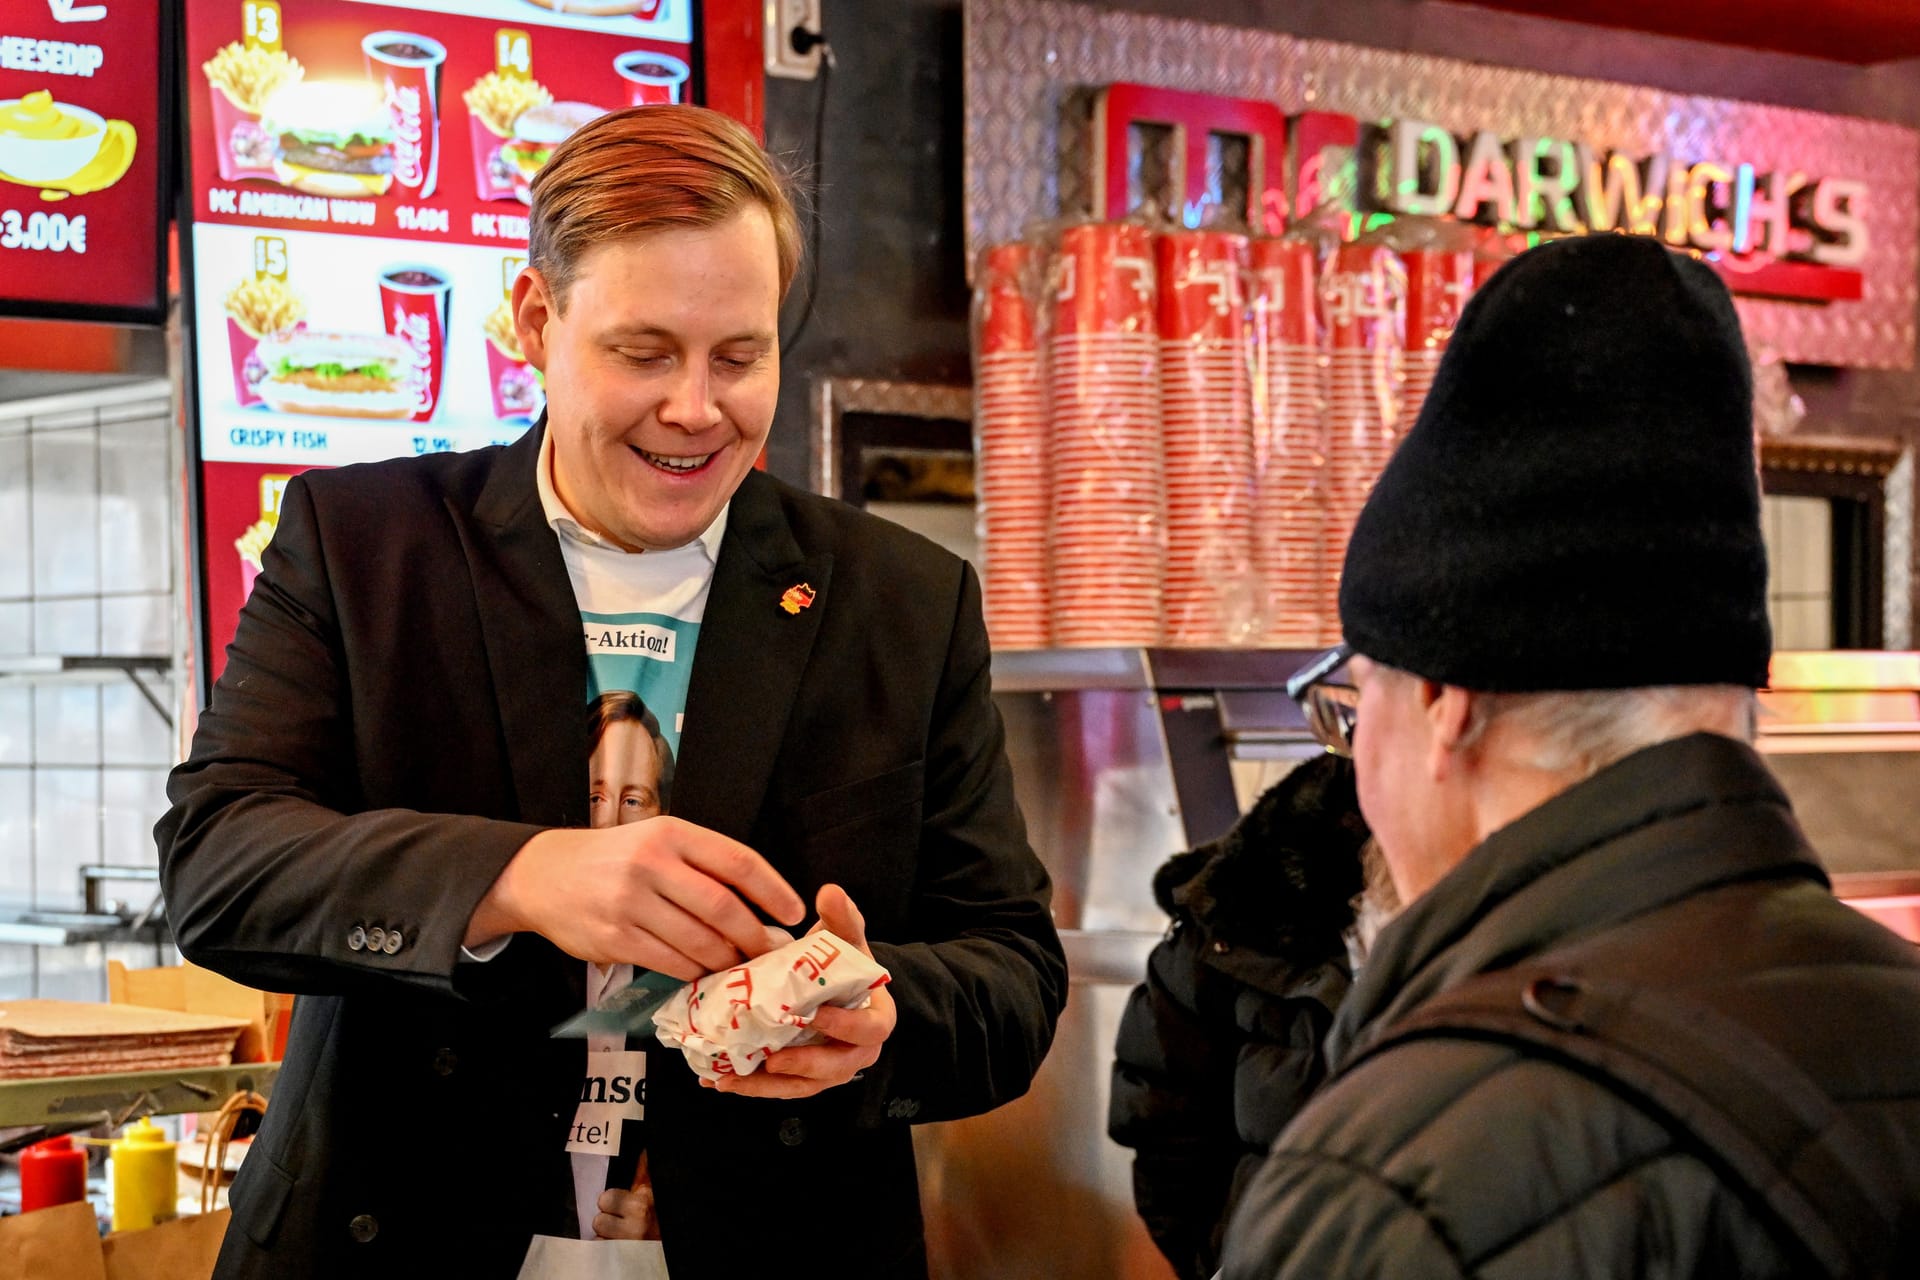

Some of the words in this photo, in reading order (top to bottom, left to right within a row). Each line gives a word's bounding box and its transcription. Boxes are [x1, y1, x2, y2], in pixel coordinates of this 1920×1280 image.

[247, 4, 279, 43] 13
[499, 35, 529, 72] 14
[256, 240, 287, 275] 15
[230, 428, 285, 448] CRISPY
[292, 431, 328, 449] FISH
[585, 630, 668, 654] -Aktion!
